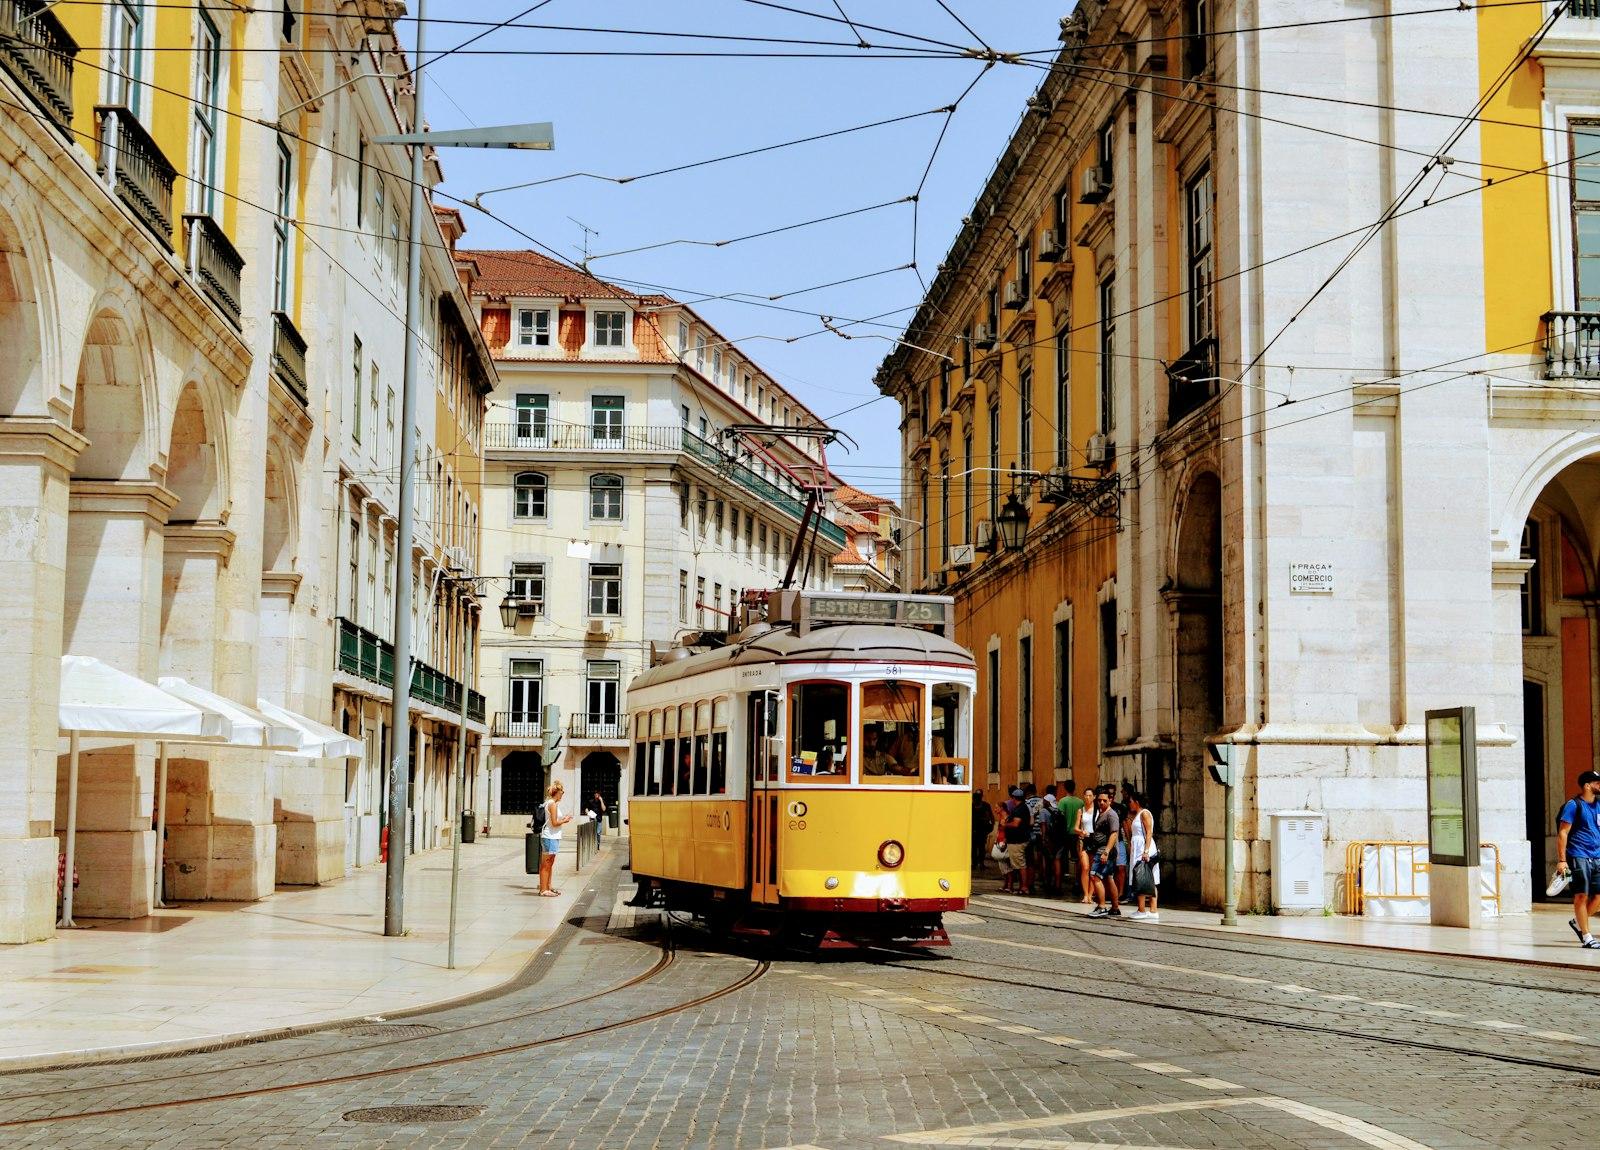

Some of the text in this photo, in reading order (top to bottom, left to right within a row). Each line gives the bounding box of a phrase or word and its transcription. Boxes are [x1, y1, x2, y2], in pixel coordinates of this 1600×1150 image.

[1297, 563, 1327, 571] PRAÇA
[906, 602, 933, 620] 25
[885, 666, 902, 675] 581
